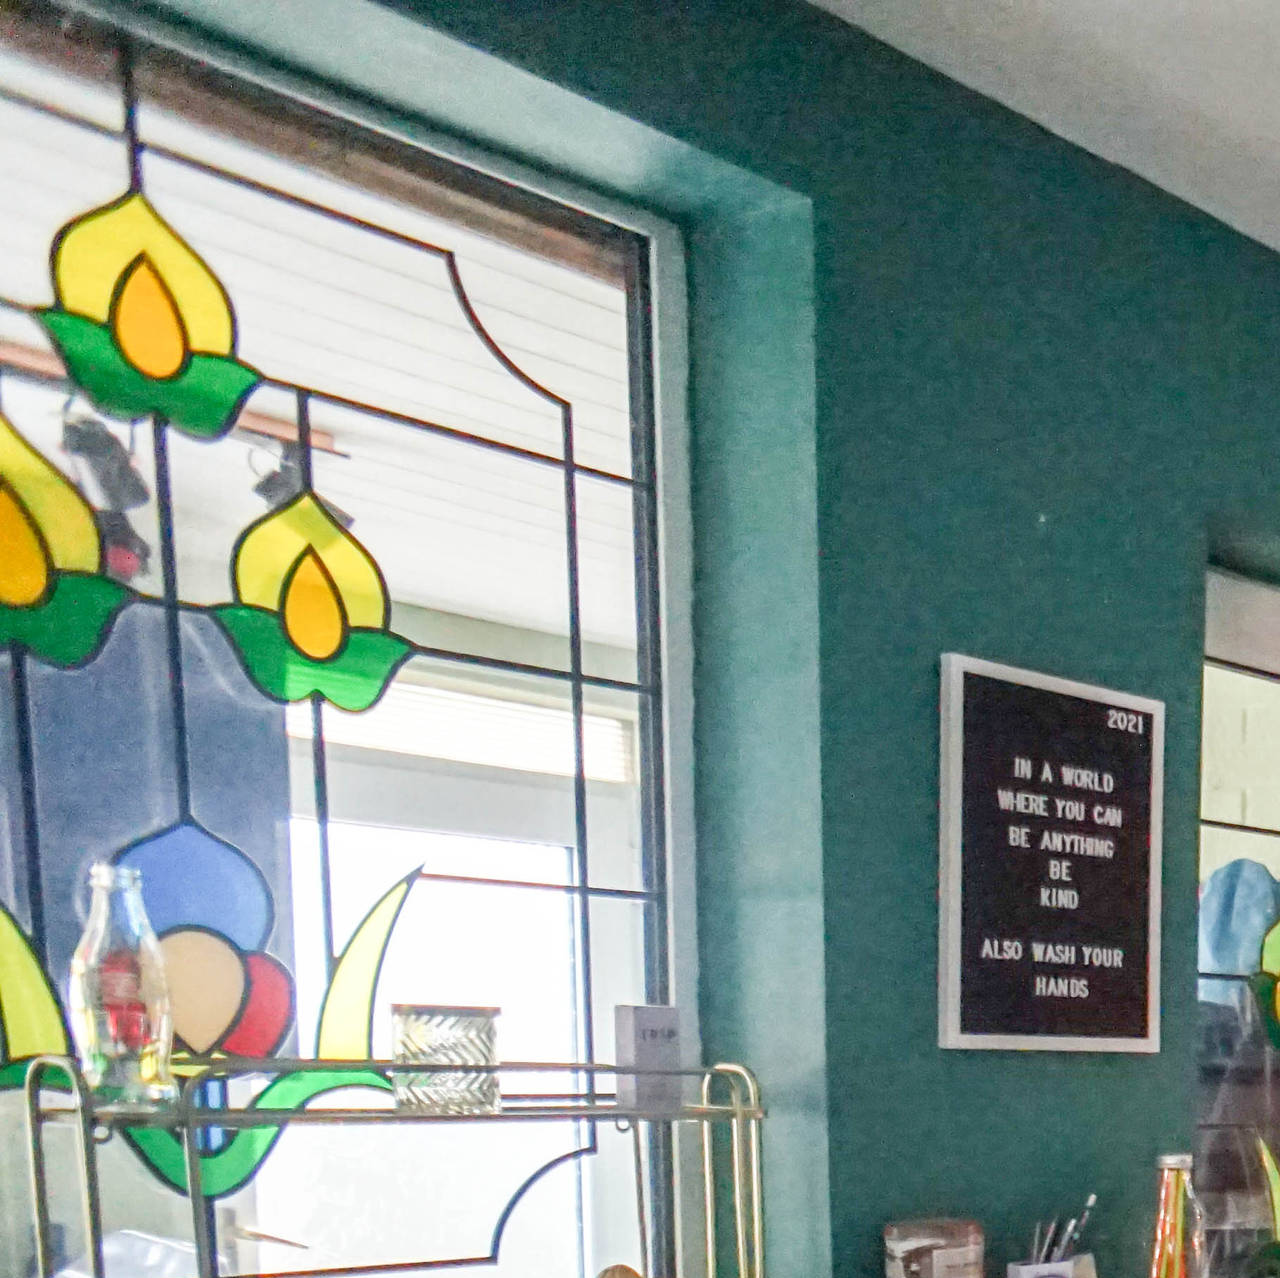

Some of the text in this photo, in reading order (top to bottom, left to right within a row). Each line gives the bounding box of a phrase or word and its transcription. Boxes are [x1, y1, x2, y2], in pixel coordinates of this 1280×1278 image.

[1107, 708, 1145, 735] 2021
[1013, 756, 1115, 794] IN A WORLD
[997, 788, 1123, 829] WHERE YOU CAN
[1008, 825, 1115, 859] BE ANYTHING
[1049, 859, 1073, 882] BE
[1040, 887, 1080, 910] KIND
[981, 938, 1125, 969] ALSO WASH YOUR
[1034, 976, 1090, 999] HANDS
